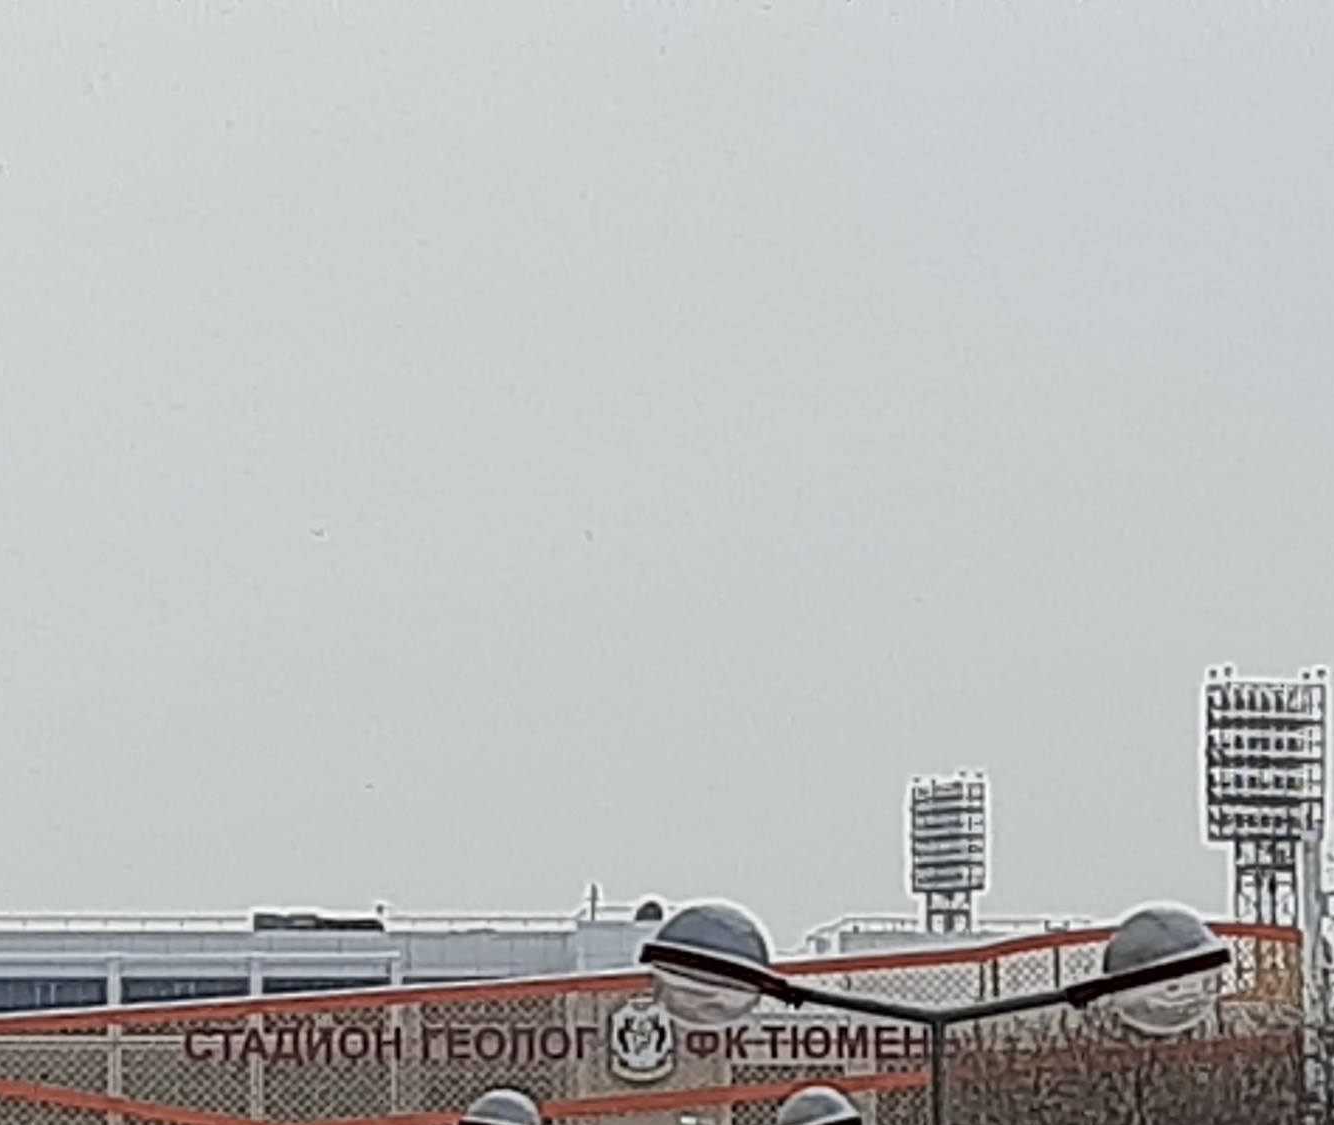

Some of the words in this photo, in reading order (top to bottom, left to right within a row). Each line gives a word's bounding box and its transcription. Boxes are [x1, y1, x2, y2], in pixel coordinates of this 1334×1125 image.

[185, 1026, 402, 1065] СТАДИОН
[421, 1026, 598, 1060] ГЕОЛОГ
[686, 1027, 750, 1060] ФК
